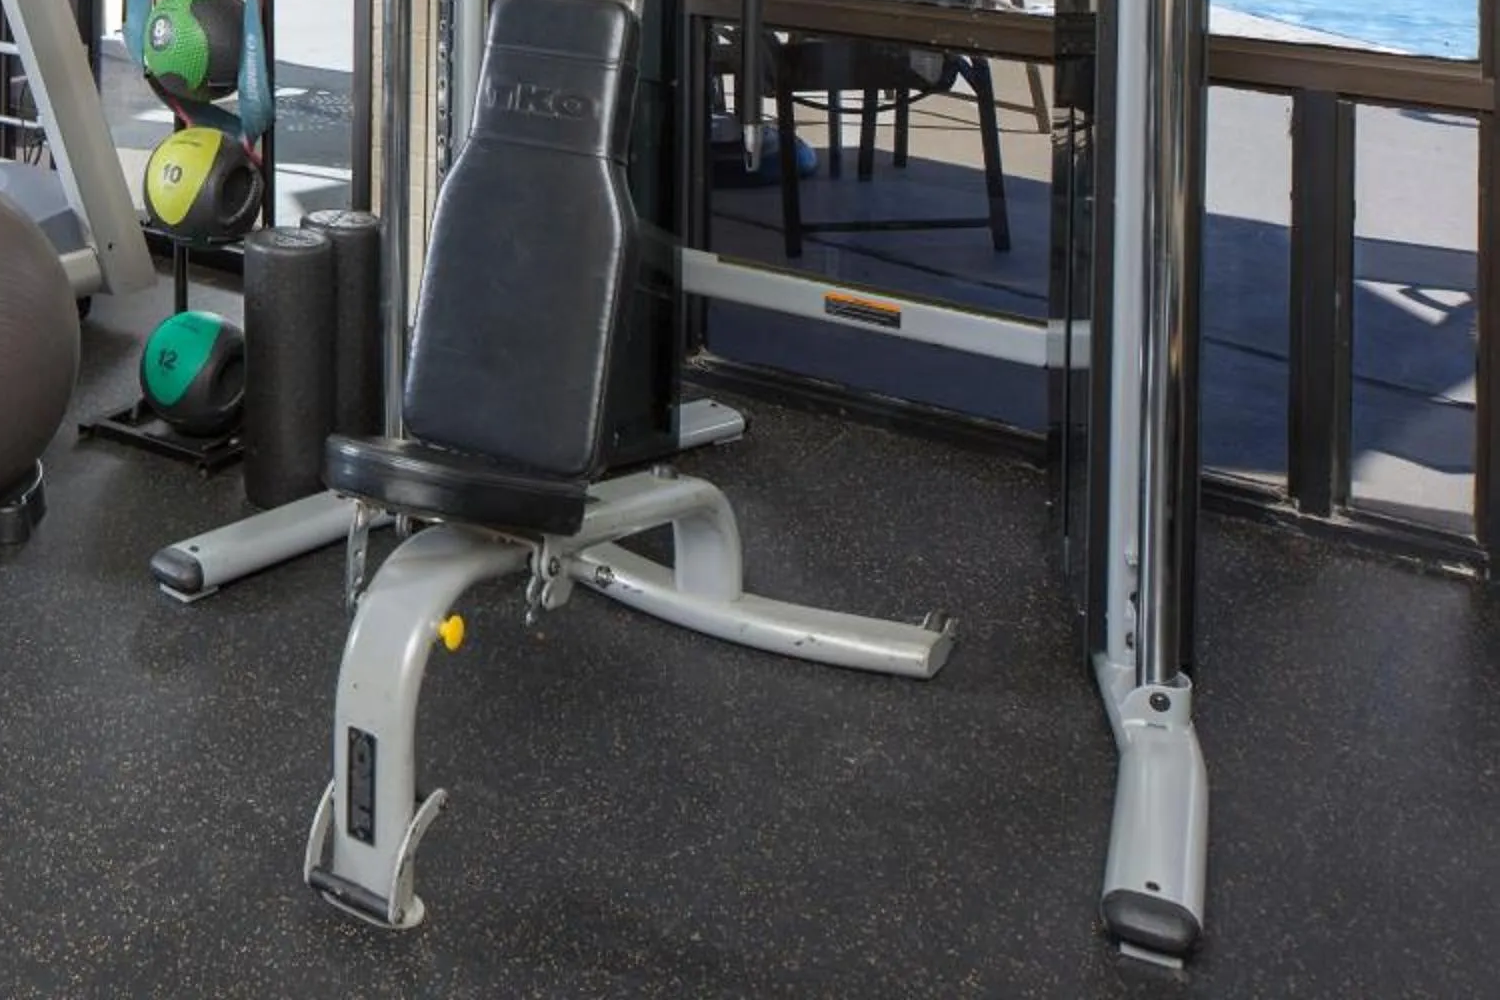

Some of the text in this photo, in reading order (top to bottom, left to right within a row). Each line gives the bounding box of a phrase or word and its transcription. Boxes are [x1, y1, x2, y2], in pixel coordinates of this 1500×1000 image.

[154, 18, 165, 37] 8
[163, 163, 183, 184] 10
[159, 348, 179, 371] 12
